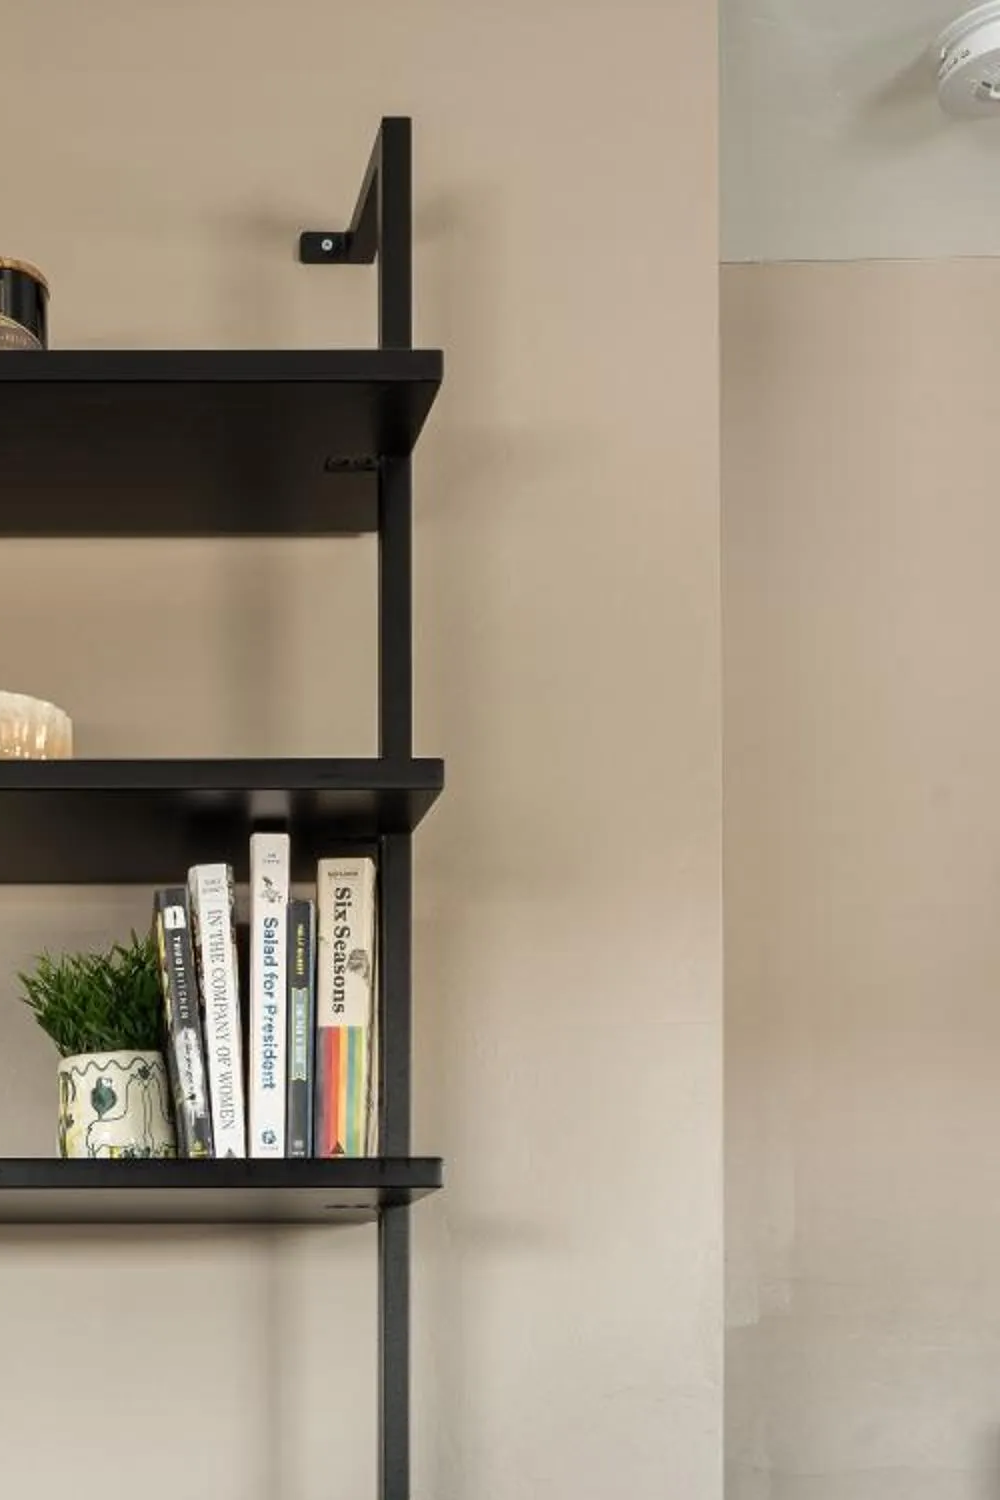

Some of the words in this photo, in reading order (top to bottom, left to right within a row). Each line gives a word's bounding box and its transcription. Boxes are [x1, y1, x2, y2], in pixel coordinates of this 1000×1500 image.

[207, 909, 224, 927] IN
[333, 887, 353, 922] Six
[209, 929, 225, 964] THE
[262, 917, 279, 967] Salad
[263, 972, 278, 999] for
[332, 926, 351, 1014] Seasons
[211, 967, 231, 1041] COMPANY
[217, 1046, 232, 1067] OF
[262, 1004, 279, 1090] President
[219, 1070, 236, 1130] WOMEN
